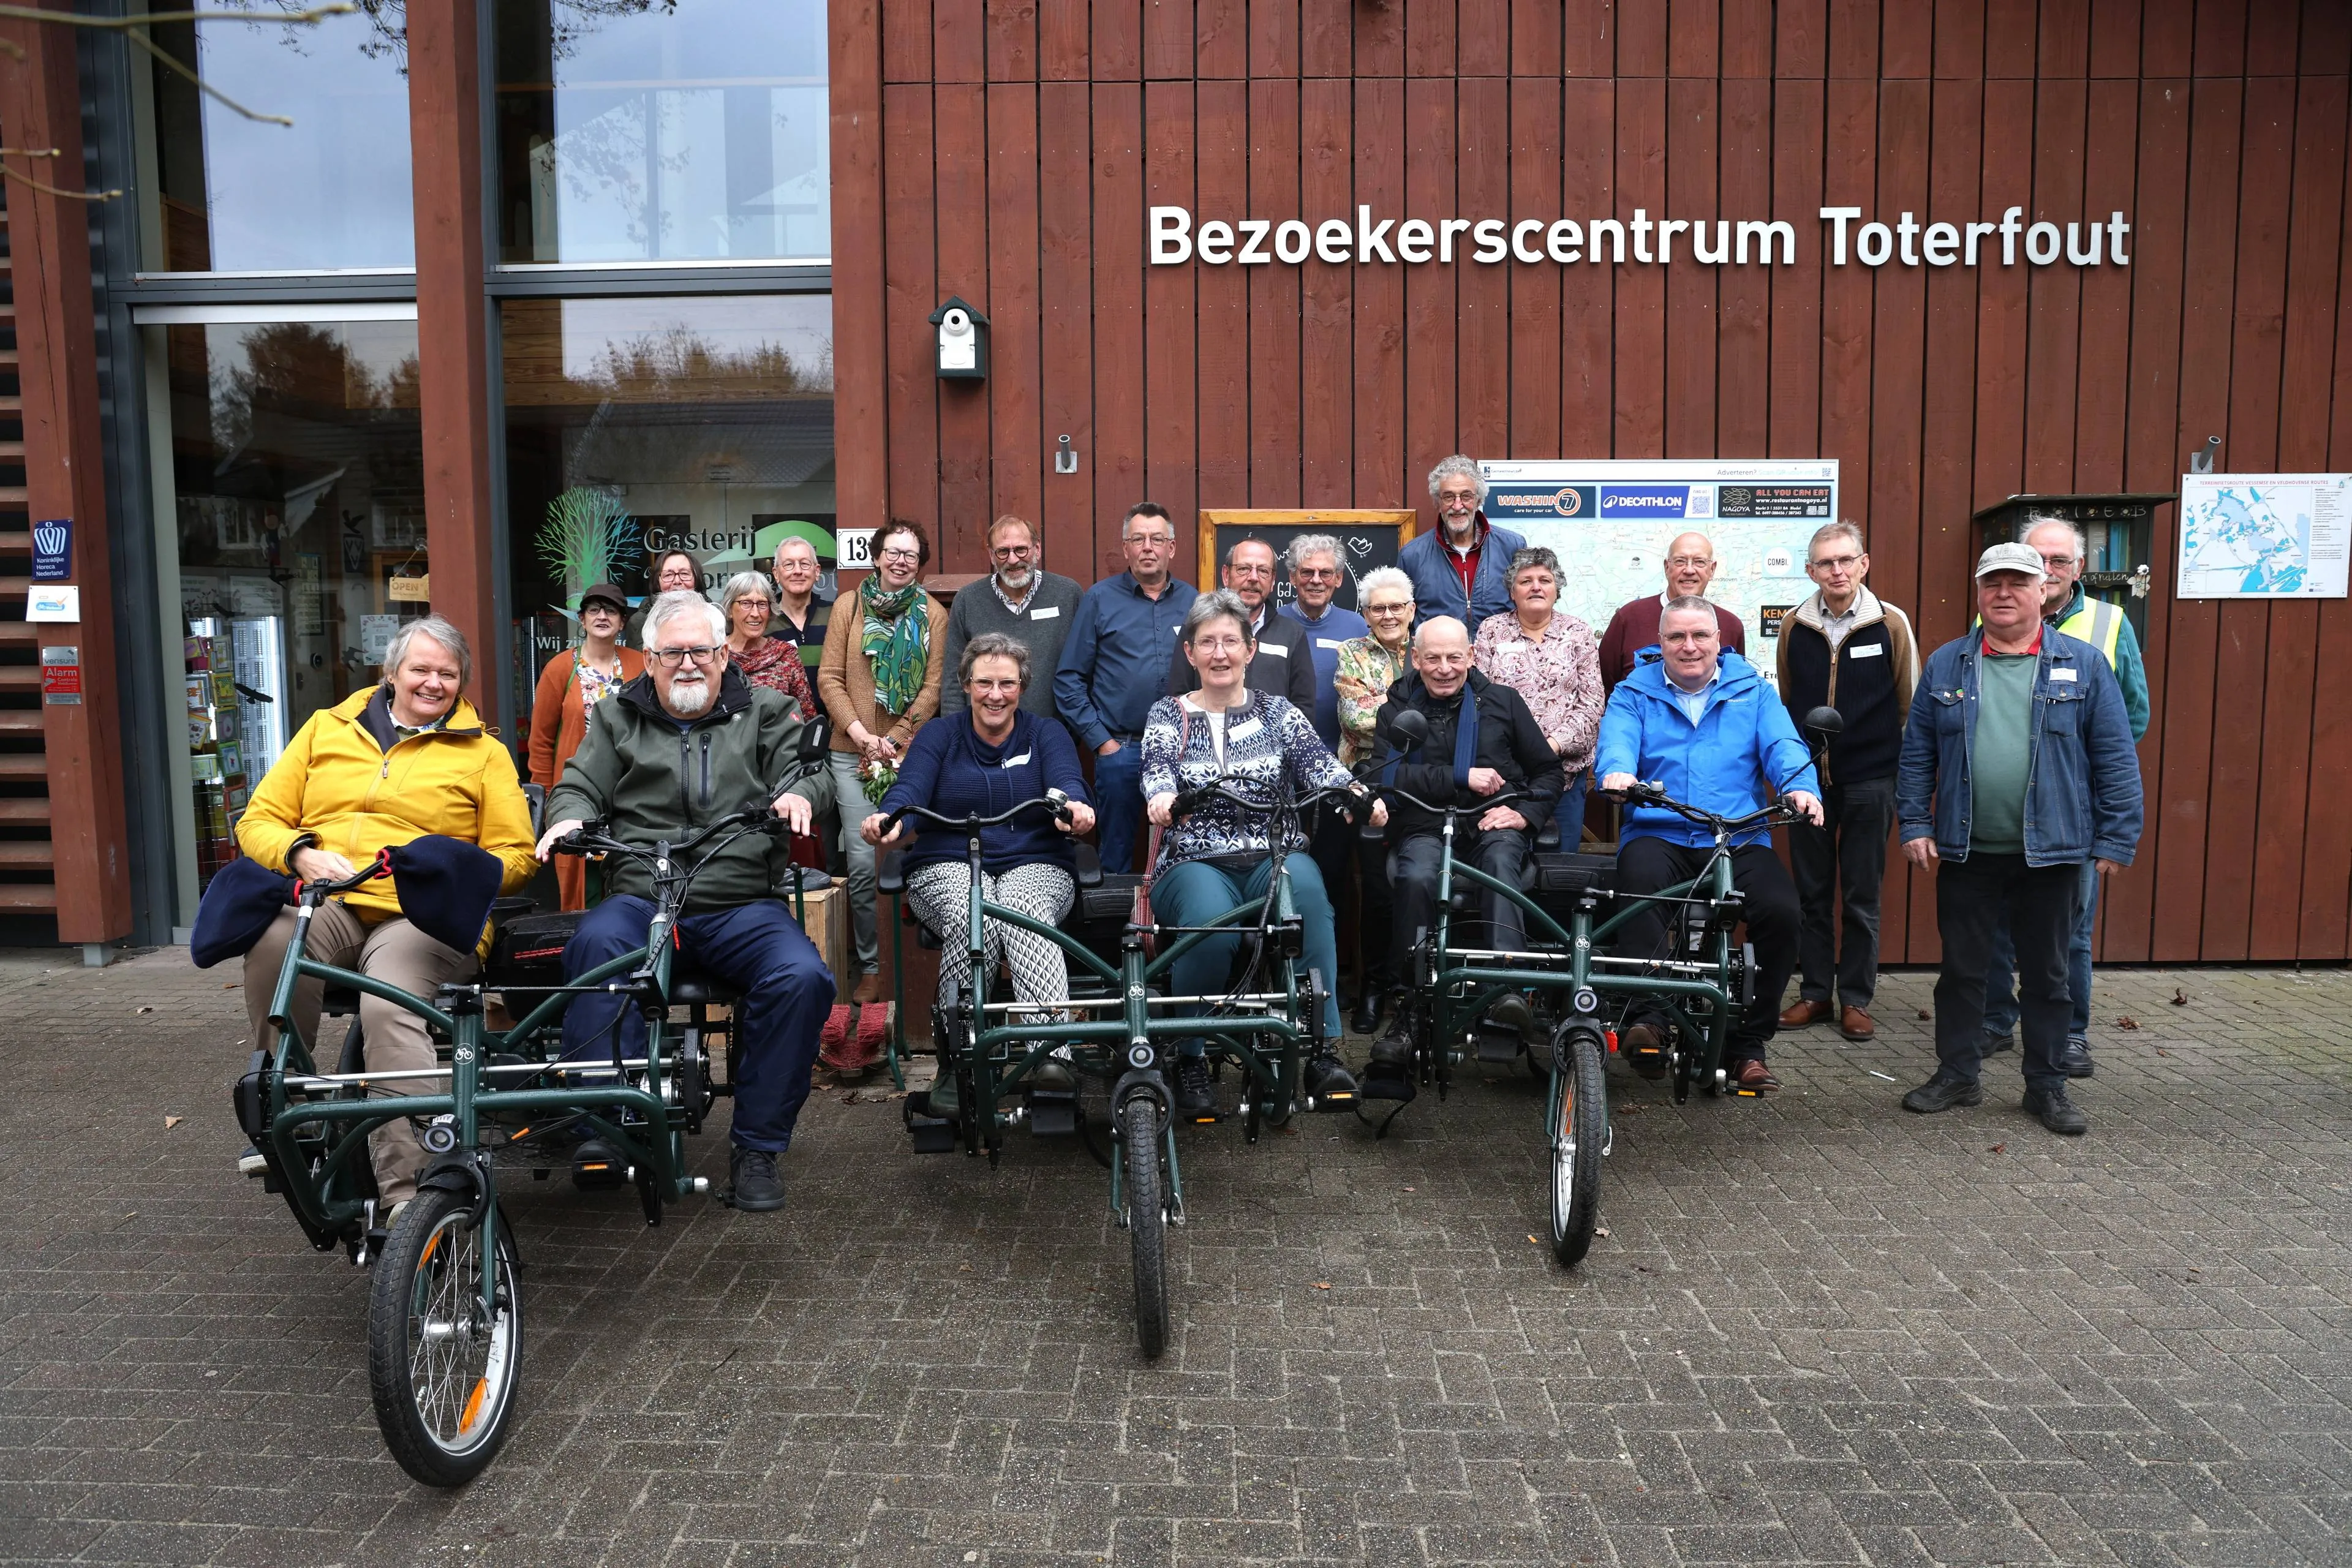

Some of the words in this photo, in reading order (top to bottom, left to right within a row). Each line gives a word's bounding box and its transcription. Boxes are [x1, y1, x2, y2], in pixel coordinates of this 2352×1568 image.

[1150, 205, 1795, 264] Bezoekerscentrum
[1820, 206, 2130, 265] Toterfout
[1498, 495, 1559, 506] WASHIN
[1561, 495, 1575, 509] 7
[1619, 497, 1682, 507] DECATHLON
[644, 525, 756, 556] Gasterij
[848, 537, 867, 560] 13
[392, 582, 419, 592] OPEN
[1763, 609, 1788, 619] KEM
[536, 636, 560, 652] Wij
[46, 668, 77, 677] Alarm
